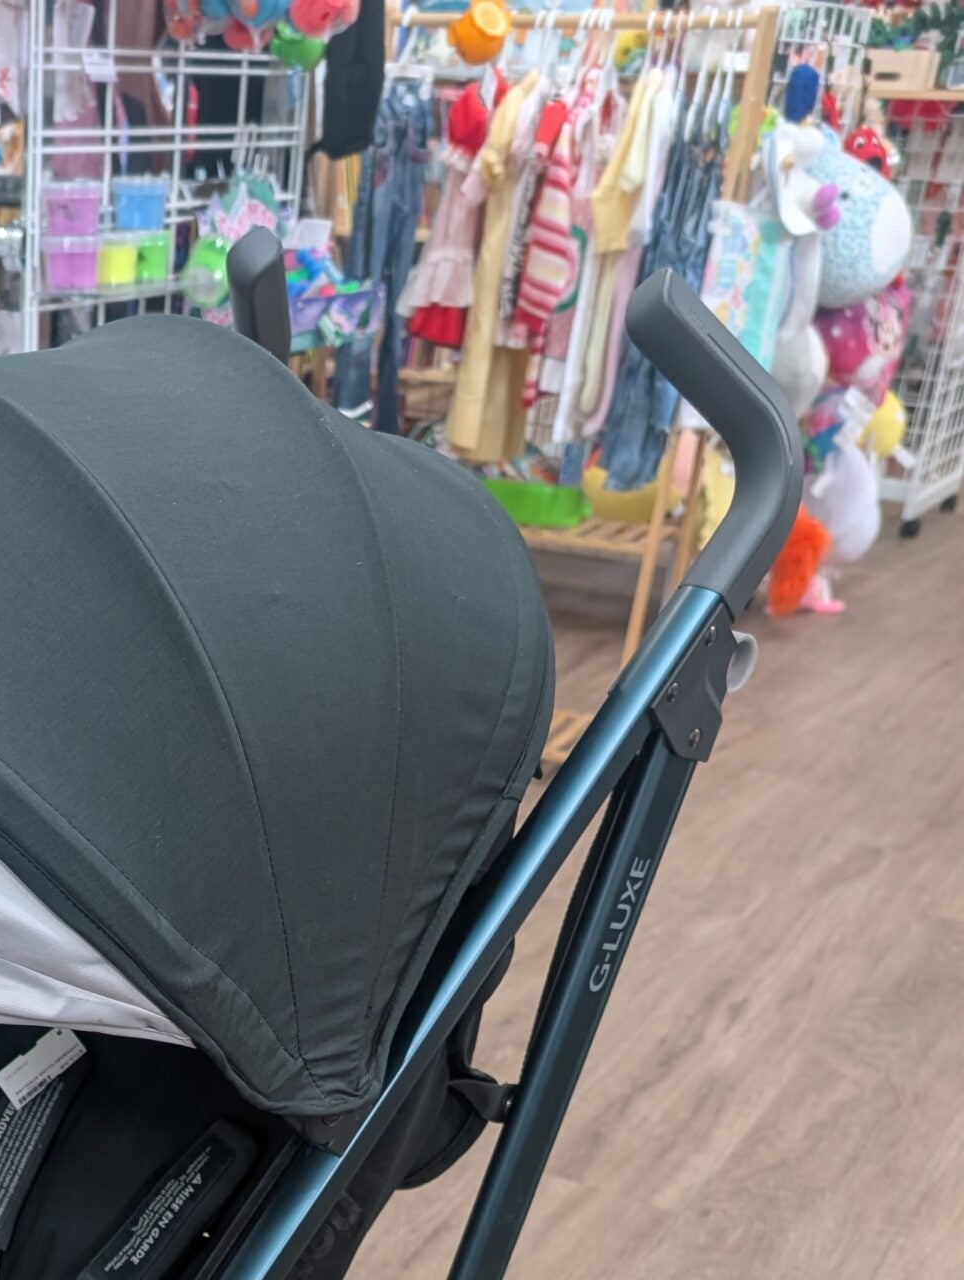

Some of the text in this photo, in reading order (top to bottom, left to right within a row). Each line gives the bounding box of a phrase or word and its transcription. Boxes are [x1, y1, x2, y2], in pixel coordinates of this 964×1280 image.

[589, 857, 651, 992] G-LUXE
[130, 1184, 195, 1266] MISE EN GARDE
